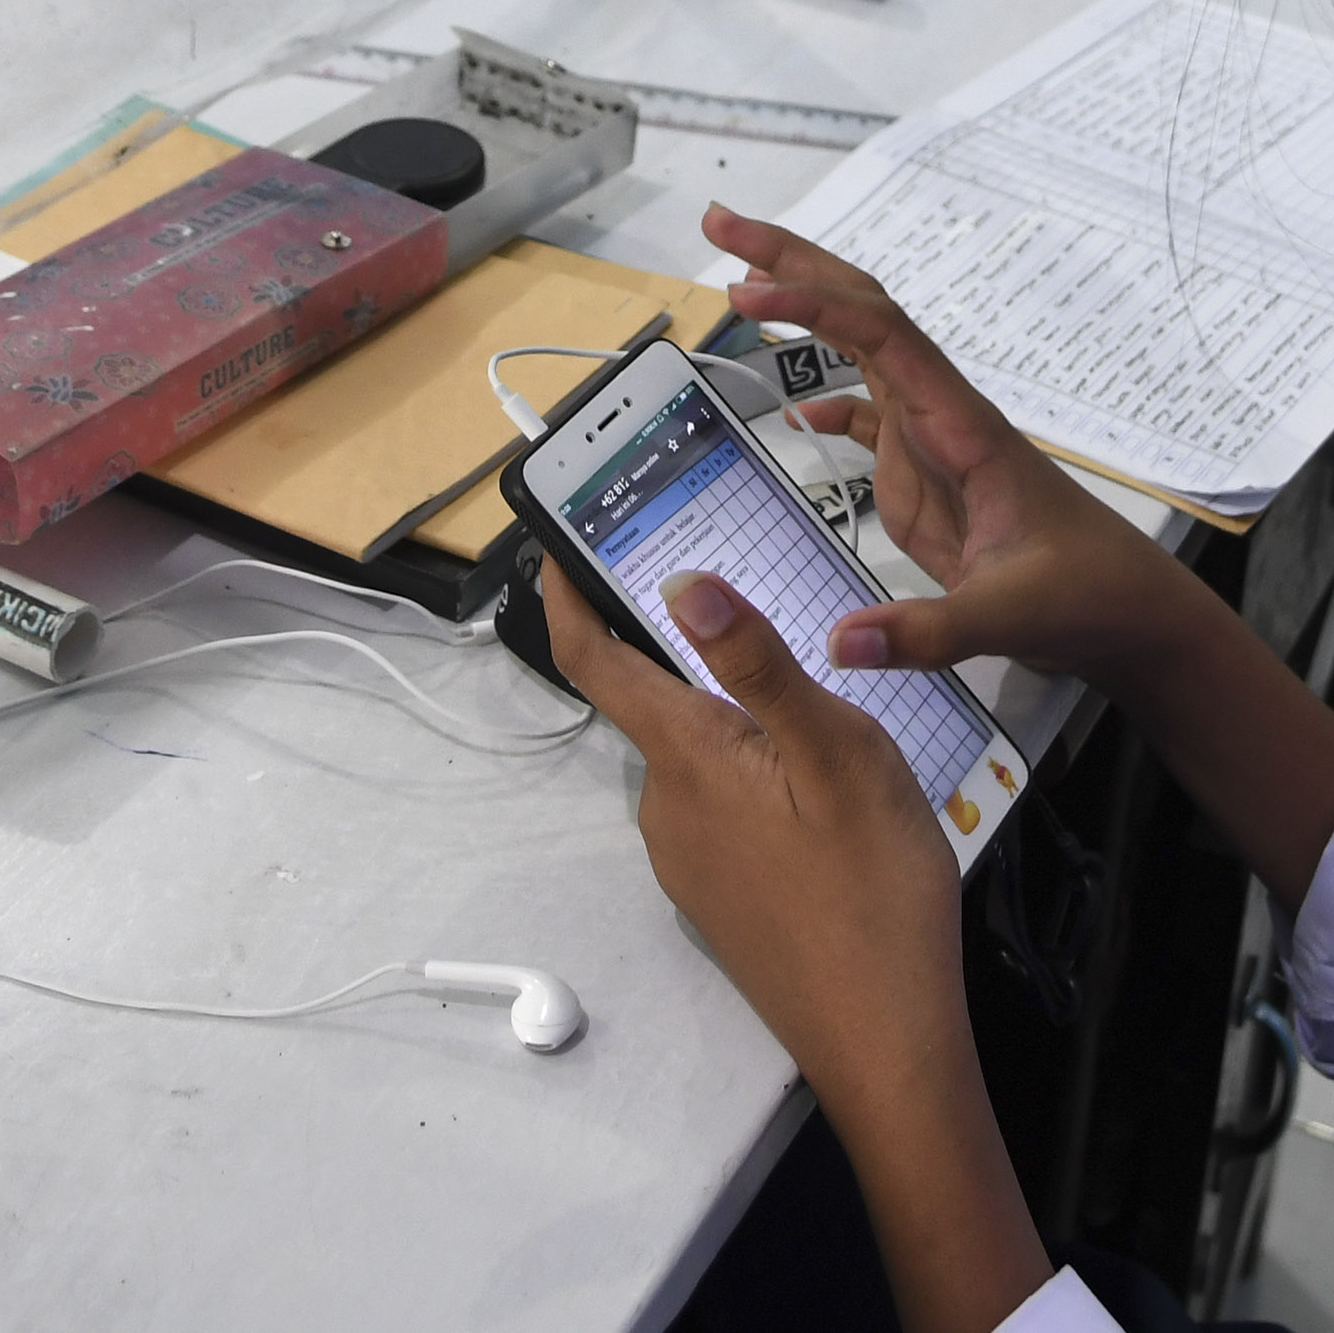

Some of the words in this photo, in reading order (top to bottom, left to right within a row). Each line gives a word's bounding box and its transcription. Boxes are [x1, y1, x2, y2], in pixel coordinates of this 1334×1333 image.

[200, 325, 295, 399] CULTURE
[605, 527, 640, 557] Pernyataan
[622, 561, 641, 579] waktu
[638, 544, 660, 563] khusus
[659, 528, 677, 546] untuk
[638, 578, 655, 595] tugas
[654, 565, 667, 580] dari
[679, 546, 691, 558] dan
